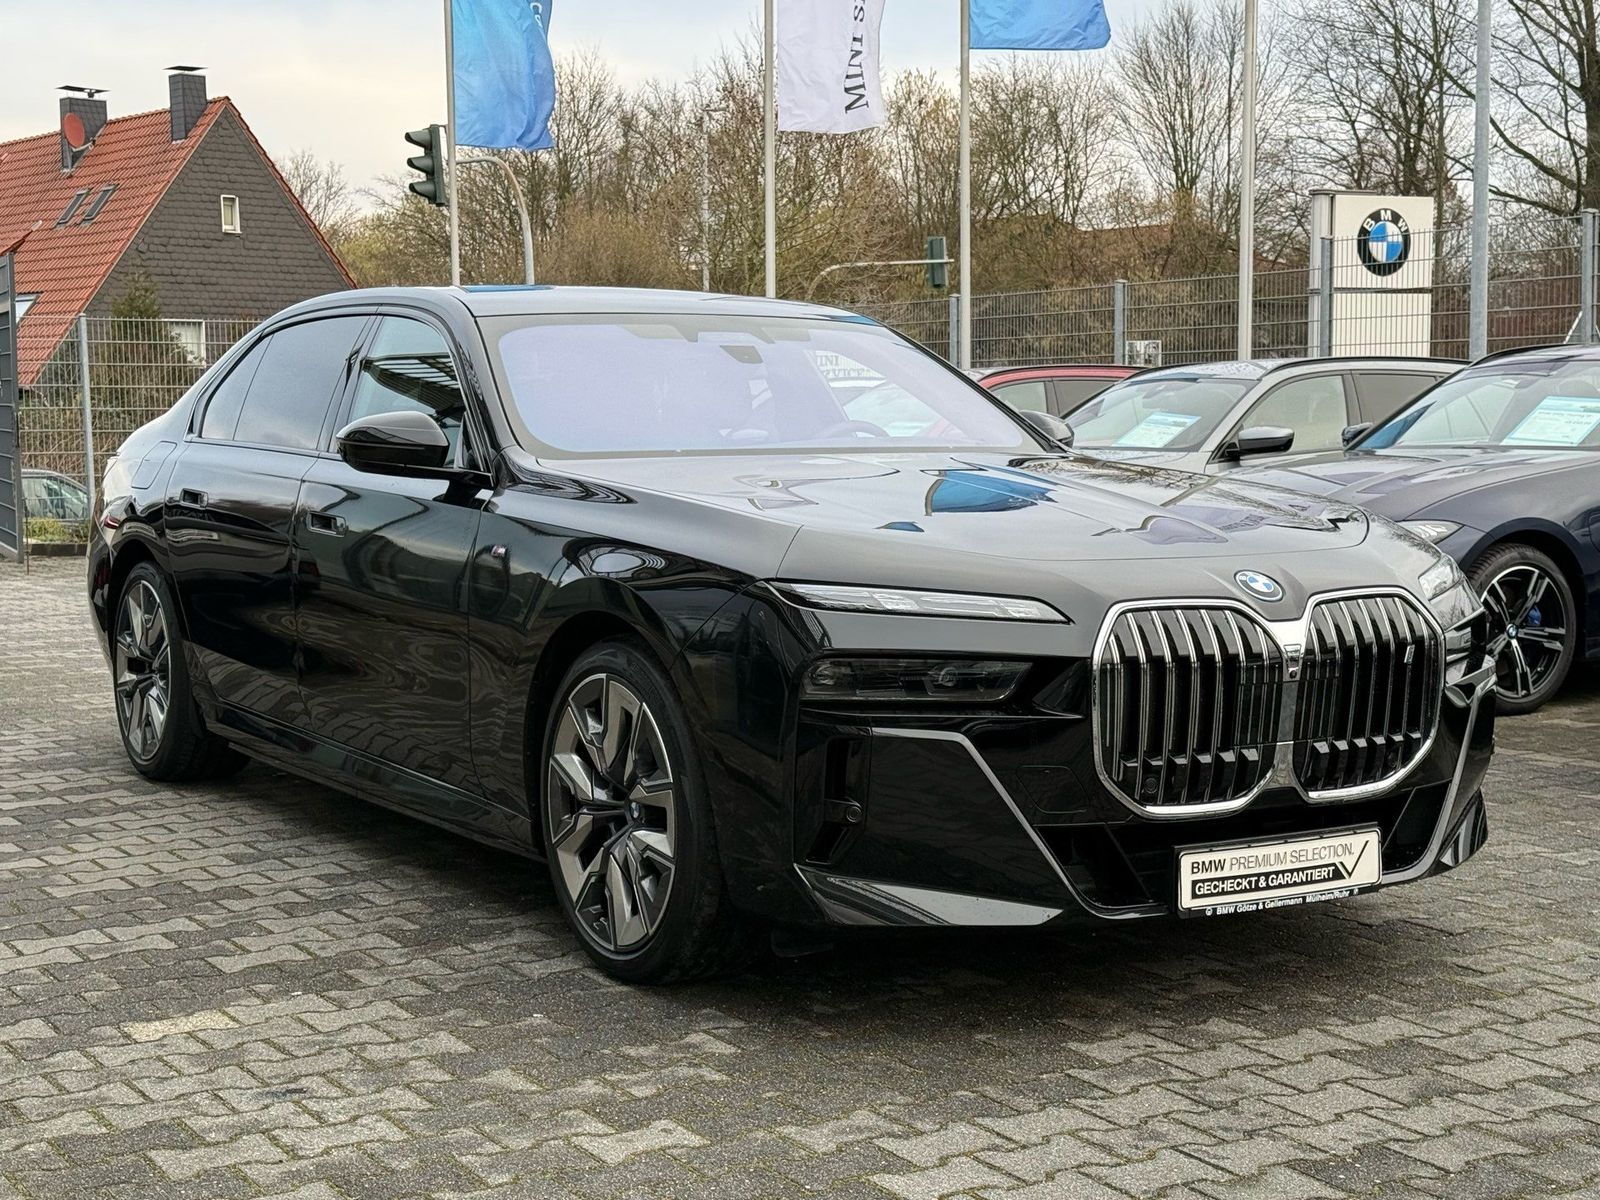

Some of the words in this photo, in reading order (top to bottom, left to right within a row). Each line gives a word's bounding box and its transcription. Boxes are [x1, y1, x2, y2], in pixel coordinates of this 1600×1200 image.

[843, 32, 869, 114] MINI
[1363, 209, 1408, 233] BMW
[1191, 858, 1226, 875] BMW
[1229, 852, 1288, 871] PREMIUM
[1195, 877, 1258, 895] GECHECKT
[1258, 875, 1267, 888] &
[1268, 866, 1336, 886] GARANTIERT
[1216, 904, 1236, 915] BMW
[1258, 901, 1264, 910] &
